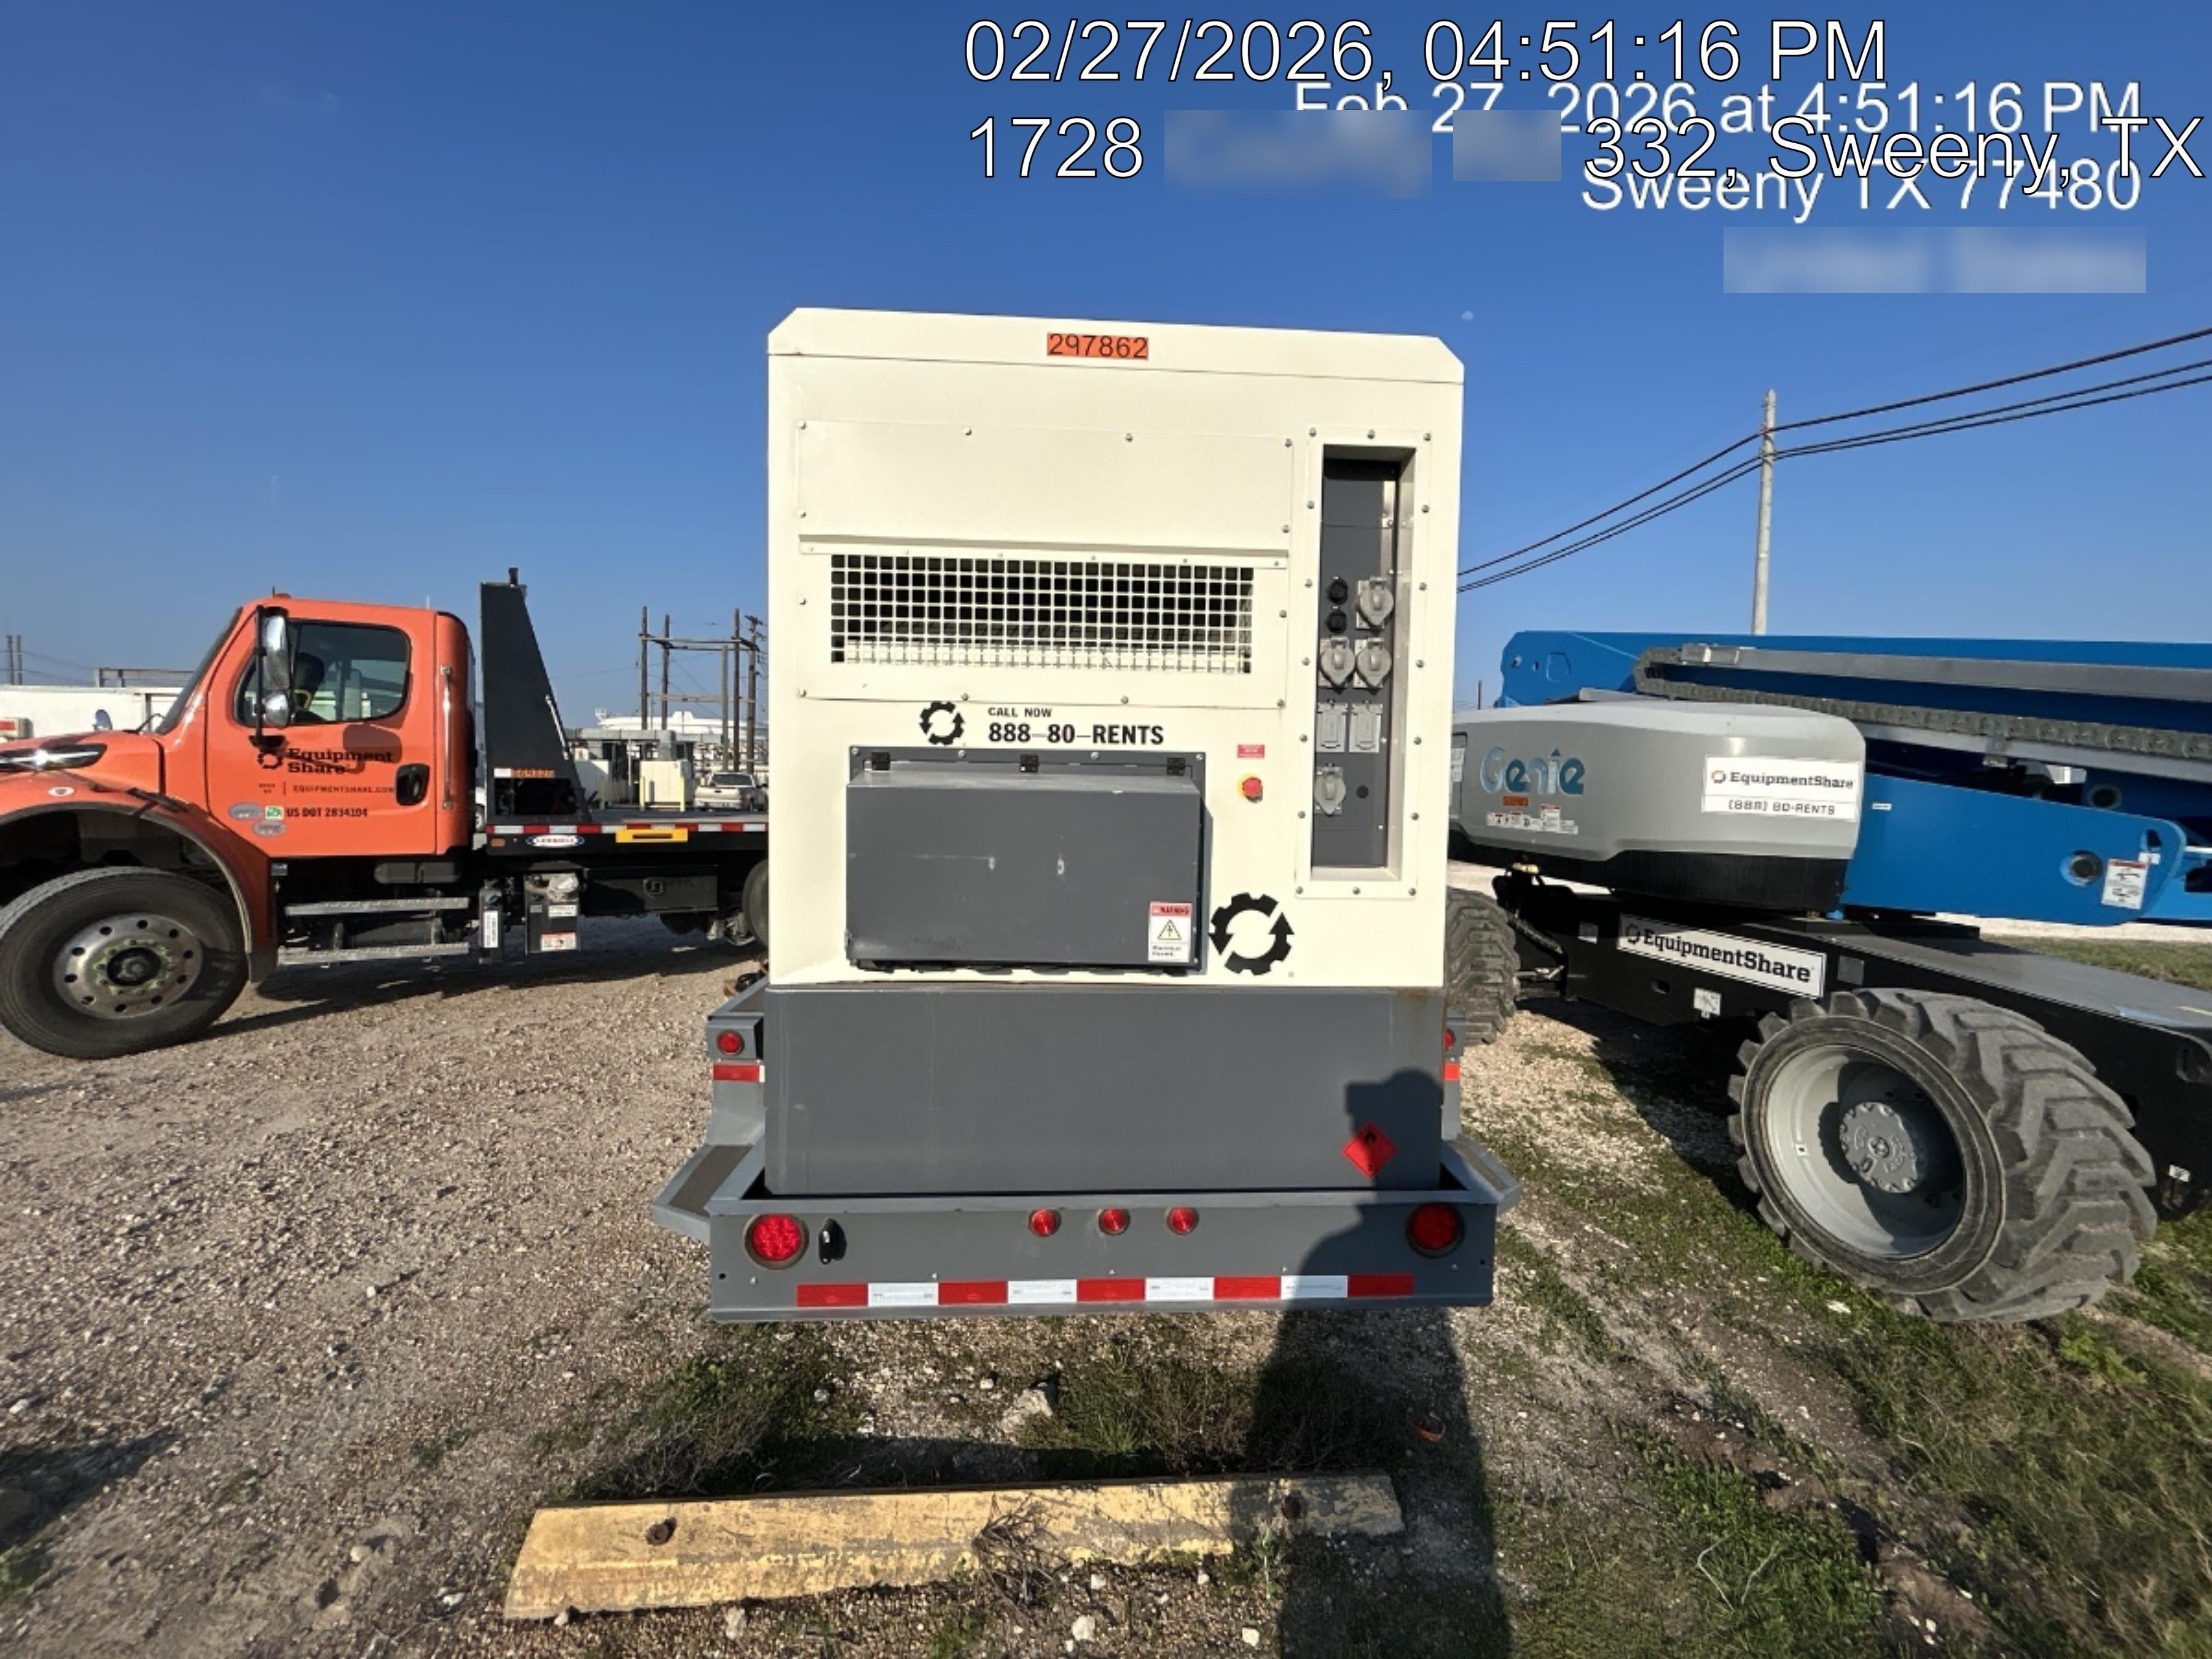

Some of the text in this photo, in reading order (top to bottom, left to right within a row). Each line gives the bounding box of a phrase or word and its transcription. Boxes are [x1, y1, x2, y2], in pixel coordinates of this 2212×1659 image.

[1049, 333, 1148, 358] 297862
[987, 707, 1053, 718] CALL NOW
[286, 747, 392, 763] Equipment
[288, 761, 345, 774] Share
[1480, 745, 1585, 795] Genie
[1730, 771, 1854, 789] EquipmentShare
[286, 807, 299, 817] US
[302, 807, 321, 817] DOT
[1643, 928, 1811, 983] EquipmentShare
